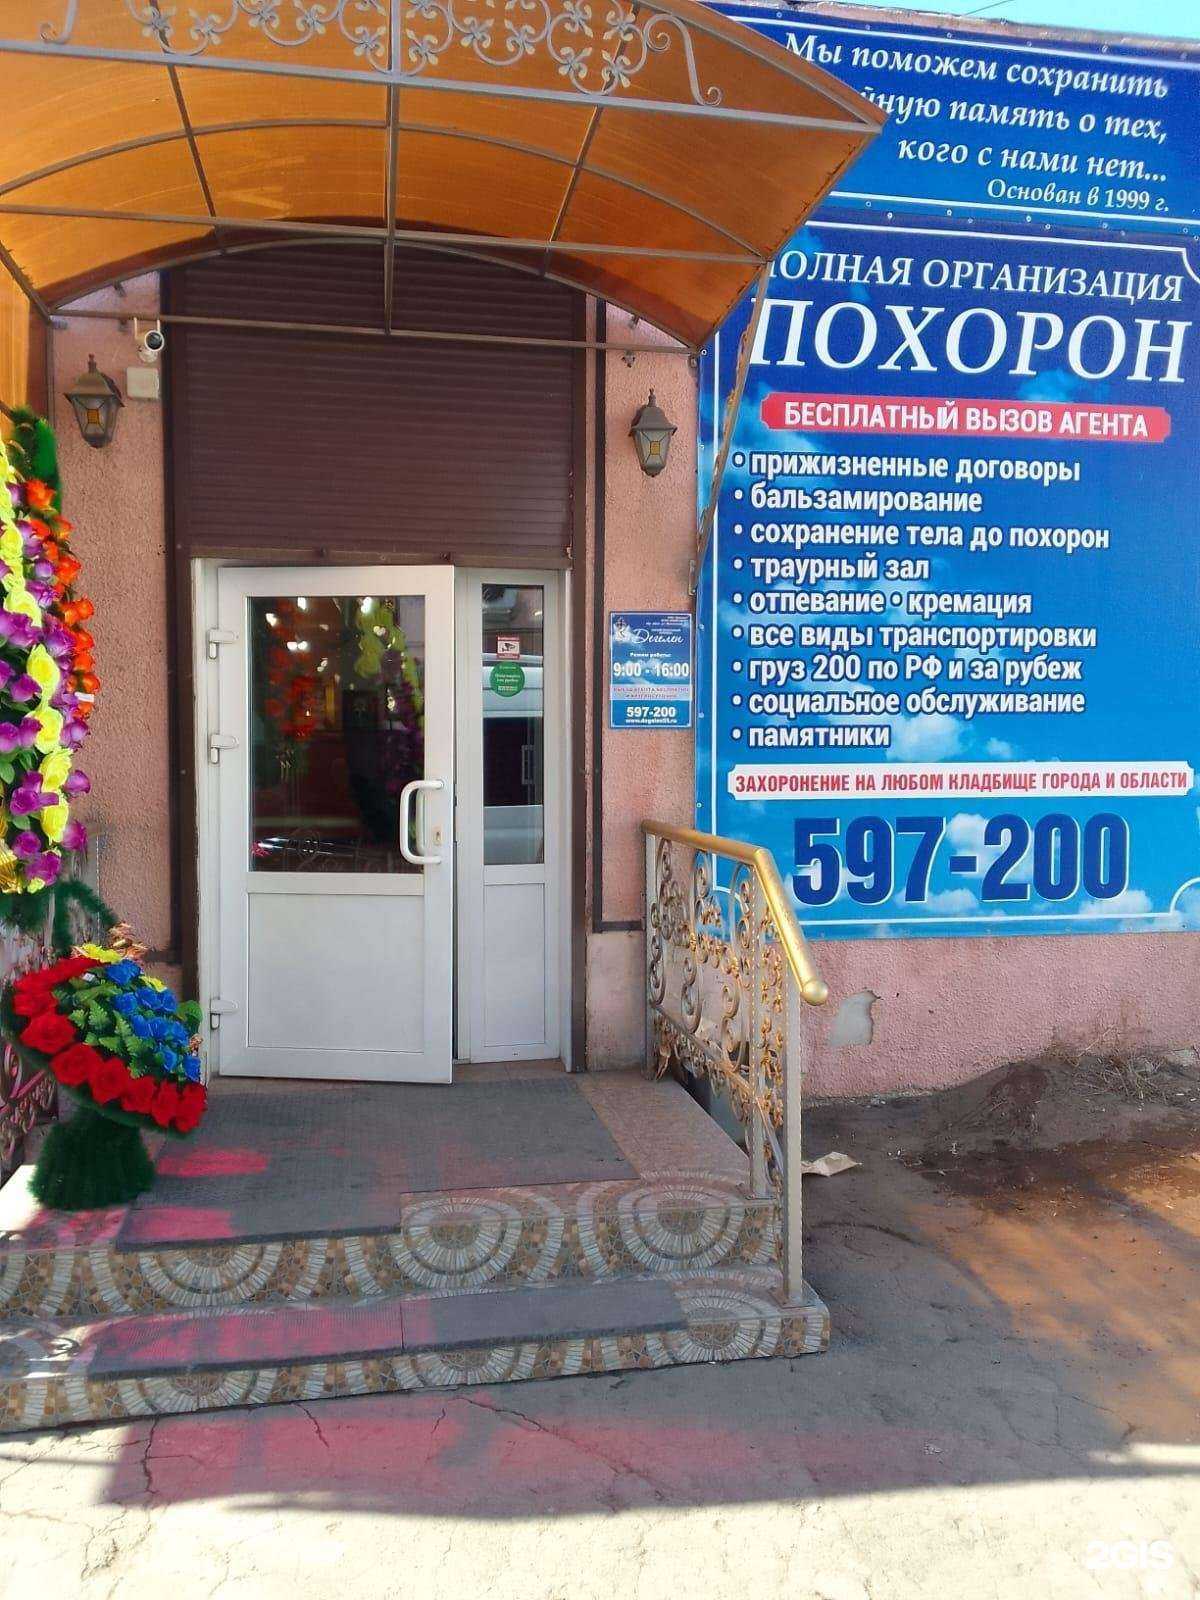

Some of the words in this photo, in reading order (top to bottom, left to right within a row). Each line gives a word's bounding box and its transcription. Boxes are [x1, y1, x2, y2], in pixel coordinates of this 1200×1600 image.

[785, 32, 842, 63] Мы
[851, 46, 998, 80] поможем
[1006, 63, 1169, 98] сохранить
[948, 100, 1070, 131] память
[1079, 113, 1096, 133] о
[1104, 115, 1168, 144] тех,
[898, 139, 969, 164] кого
[977, 147, 993, 166] с
[1000, 148, 1079, 174] нами
[1086, 155, 1167, 182] нет...
[987, 178, 1082, 204] Основан
[1087, 186, 1100, 206] в
[1104, 189, 1150, 210] 1999
[1154, 198, 1169, 212] г.
[923, 259, 1184, 304] ОРГАНИЗАЦИЯ
[750, 298, 1192, 383] ПОХОРОН
[784, 400, 959, 431] БЕСПЛАТНЫЙ
[970, 408, 1053, 434] ВЫЗОВ
[1059, 411, 1149, 437] АГЕНТА
[751, 452, 949, 483] прижизненные
[955, 457, 1080, 487] договоры
[751, 483, 982, 515] бальзамирование
[750, 522, 899, 549] сохранение
[906, 526, 963, 545] тела
[969, 527, 1003, 553] до
[1009, 527, 1109, 553] похорон
[750, 552, 878, 584] траурный
[885, 559, 929, 579] зал
[750, 591, 884, 613] отпевание
[907, 593, 1032, 620] кремация
[750, 626, 794, 647] все
[801, 626, 873, 653] виды
[879, 626, 1097, 654] транспортировки
[613, 662, 641, 677] 9:00
[655, 662, 690, 677] 16:00
[749, 660, 806, 685] груз
[812, 655, 861, 681] 200
[868, 661, 898, 680] по
[905, 654, 942, 681] РФ
[949, 662, 964, 680] и
[970, 661, 998, 680] за
[1005, 655, 1082, 686] рубеж
[626, 706, 676, 718] 597-200
[749, 692, 900, 720] социальное
[906, 689, 1085, 720] обслуживание
[749, 728, 890, 748] памятники
[735, 774, 850, 793] ЗАХОРОНЕНИЕ
[855, 773, 877, 792] НА
[882, 773, 943, 792] ЛЮБОМ
[949, 772, 1037, 793] КЛАДБИЩЕ
[1042, 771, 1101, 791] ГОРОДА
[1105, 771, 1115, 789] И
[1120, 770, 1188, 790] ОБЛАСТИ
[792, 813, 1130, 906] 597-200
